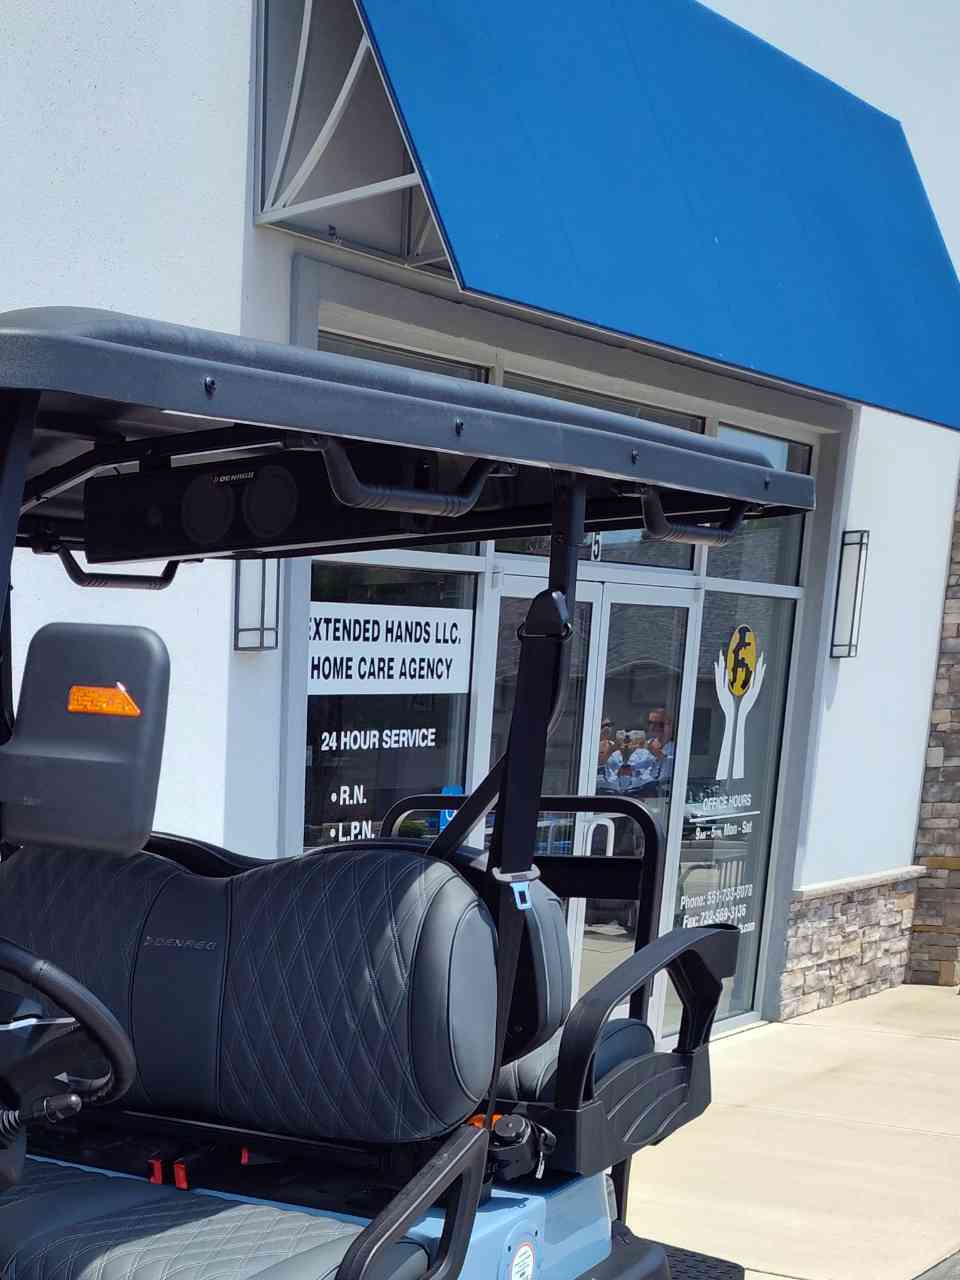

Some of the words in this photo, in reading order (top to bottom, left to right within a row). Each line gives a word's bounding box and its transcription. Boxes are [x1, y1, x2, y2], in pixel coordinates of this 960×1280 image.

[309, 617, 381, 642] XTENDED
[385, 619, 431, 644] HANDS
[310, 655, 353, 680] HOME
[357, 656, 395, 680] CARE
[399, 657, 453, 680] AGENCY
[320, 731, 338, 751] 24
[340, 730, 380, 751] HOUR
[382, 728, 437, 749] SERVICE
[339, 784, 367, 806] R.N.
[703, 796, 728, 810] OFFICE
[728, 792, 752, 808] HOURS
[338, 820, 375, 842] L.P.N.
[680, 895, 706, 910] Phone:
[682, 914, 699, 929] Fax:
